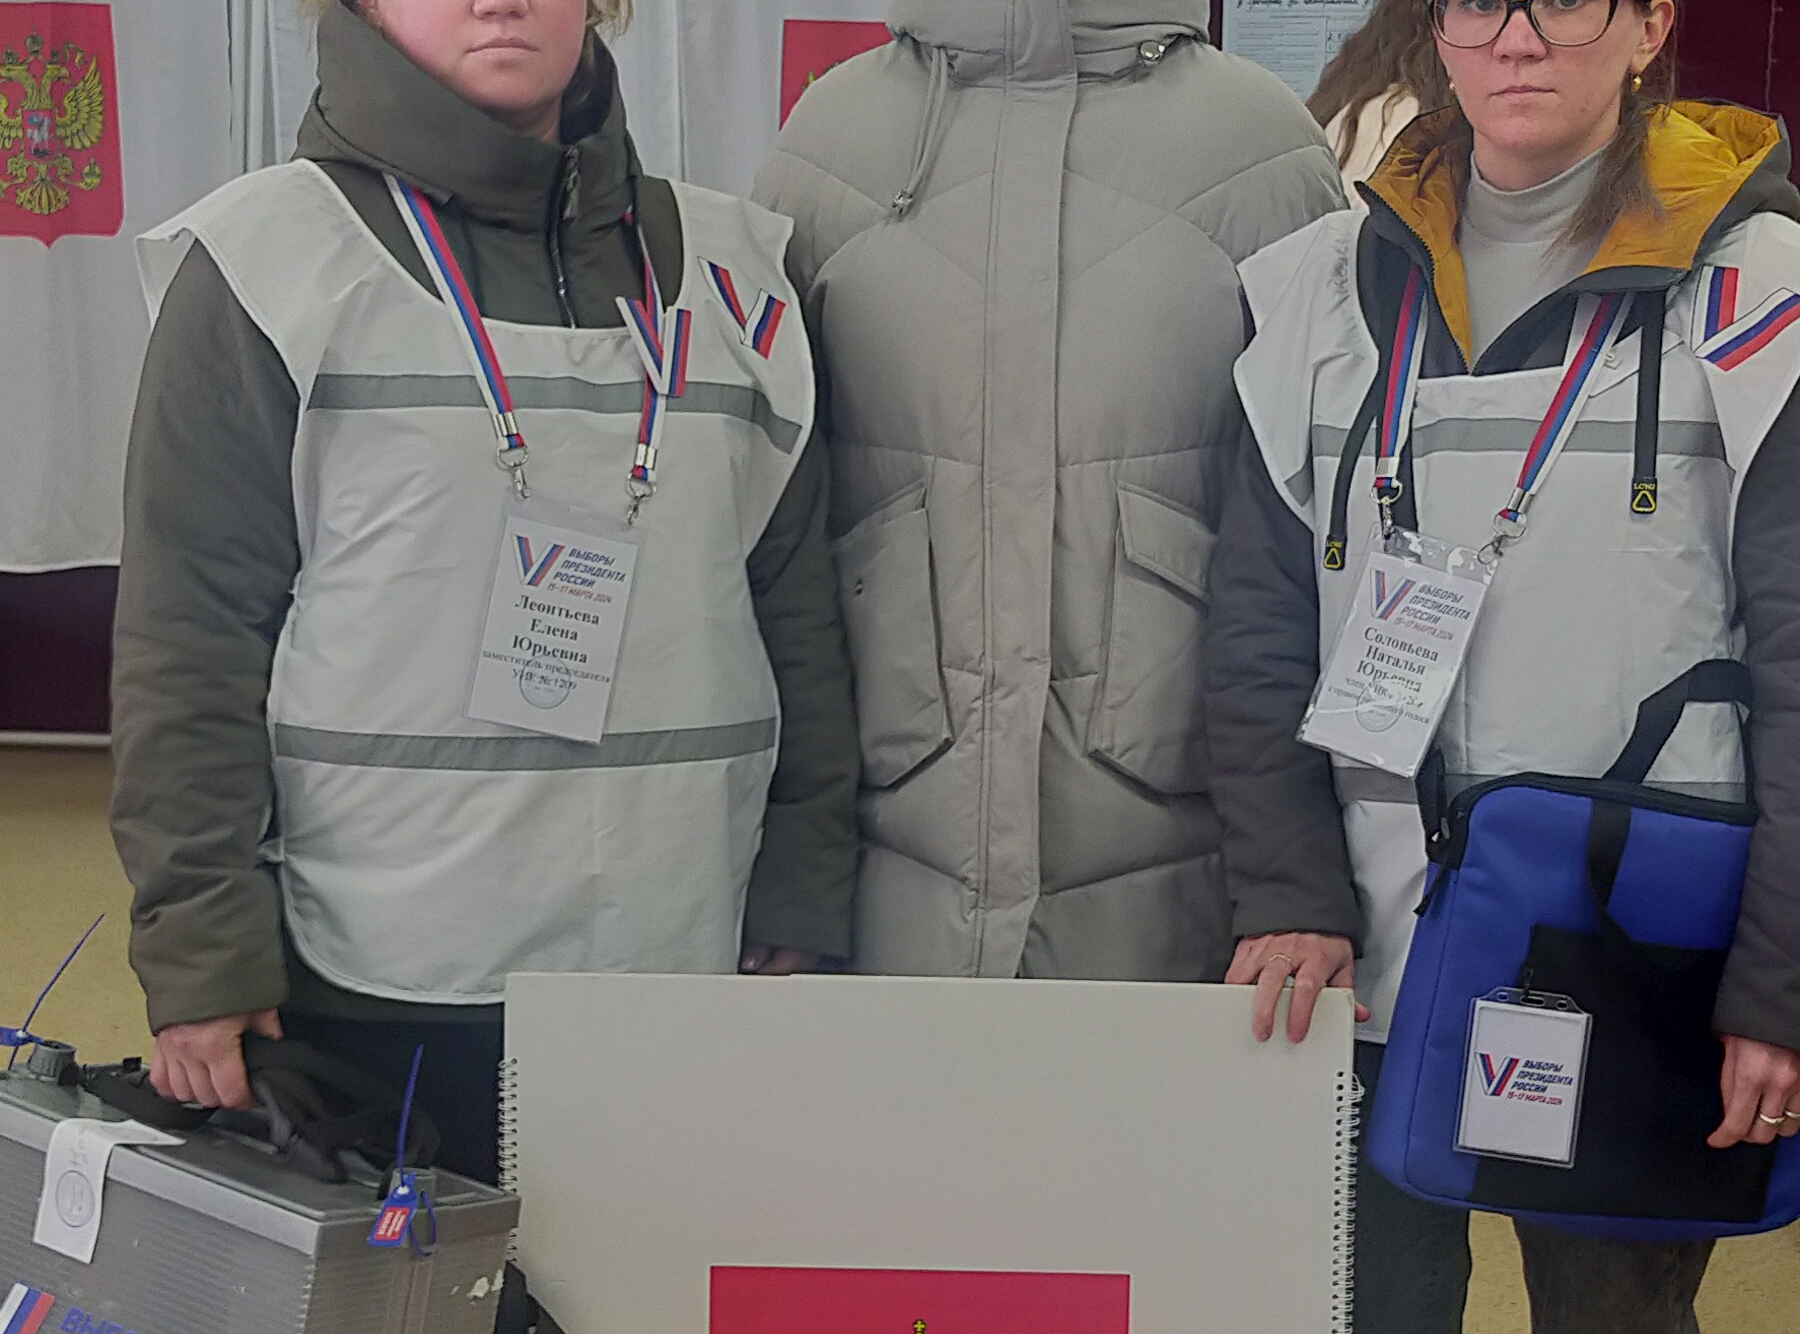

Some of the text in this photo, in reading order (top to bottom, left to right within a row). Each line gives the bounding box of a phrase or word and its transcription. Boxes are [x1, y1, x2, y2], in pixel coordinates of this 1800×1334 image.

[568, 548, 615, 565] ВЫБОРЫ
[553, 571, 596, 589] РОССИИ
[561, 559, 625, 583] ПРЕЗИДЕНТА
[569, 586, 594, 600] МАРТА
[1418, 584, 1464, 604] ВЫБОРЫ
[515, 594, 600, 625] Леонтьева
[1400, 606, 1441, 625] РОССИИ
[1409, 595, 1471, 621] ПРЕЗИДЕНТА
[530, 618, 578, 641] Елена
[512, 635, 588, 664] Юрьевна
[1364, 626, 1439, 662] Соловьева
[1365, 645, 1426, 675] Наталья
[1522, 1059, 1564, 1073] ВЫБОРЫ
[1510, 1081, 1548, 1094] РОССИИ
[1517, 1070, 1574, 1087] ПРЕЗИДЕНТА
[1525, 1092, 1547, 1105] МАРТА
